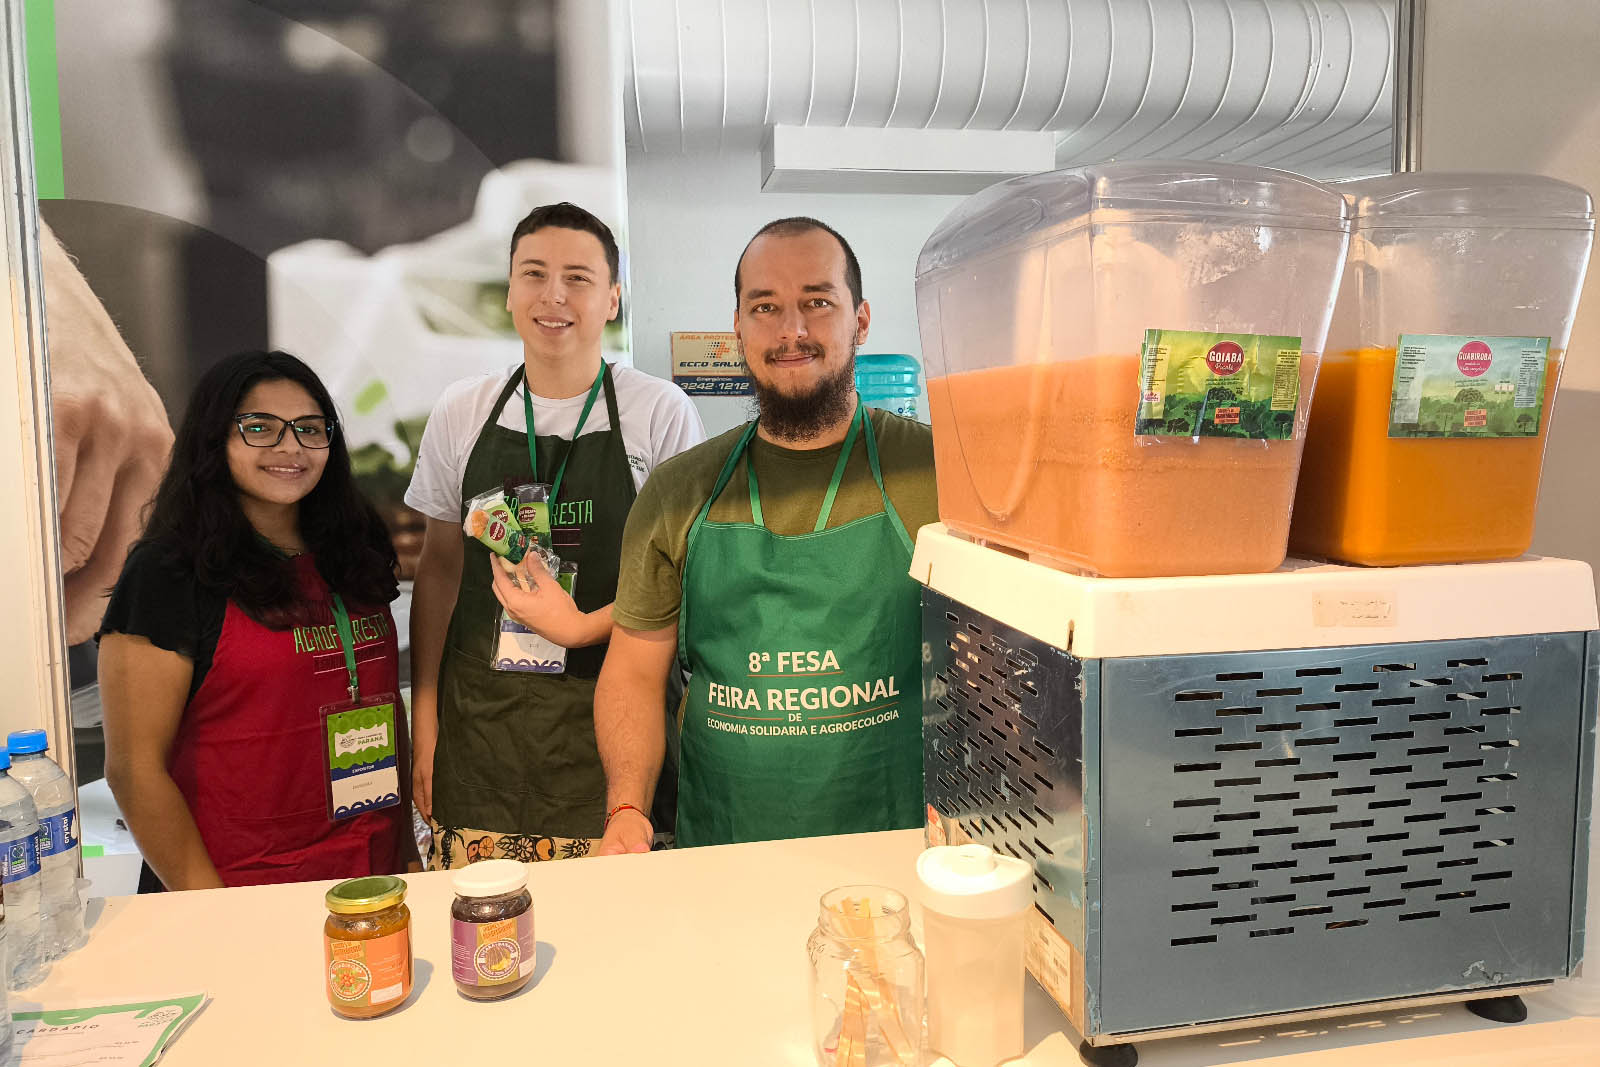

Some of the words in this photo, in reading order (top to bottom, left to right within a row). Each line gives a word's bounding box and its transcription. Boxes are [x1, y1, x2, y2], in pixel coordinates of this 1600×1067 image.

[1209, 350, 1242, 363] GOIABA
[1458, 351, 1493, 361] GUABIROBA
[293, 612, 391, 654] AGROFRESTA
[777, 650, 840, 673] FESA
[708, 682, 761, 711] FEIRA
[767, 676, 900, 711] REGIONAL
[707, 717, 748, 735] ECONOMIA
[750, 725, 808, 736] SOLIDARIA
[810, 725, 817, 735] E
[819, 709, 899, 735] AGROECOLOGIA
[788, 713, 802, 722] DE
